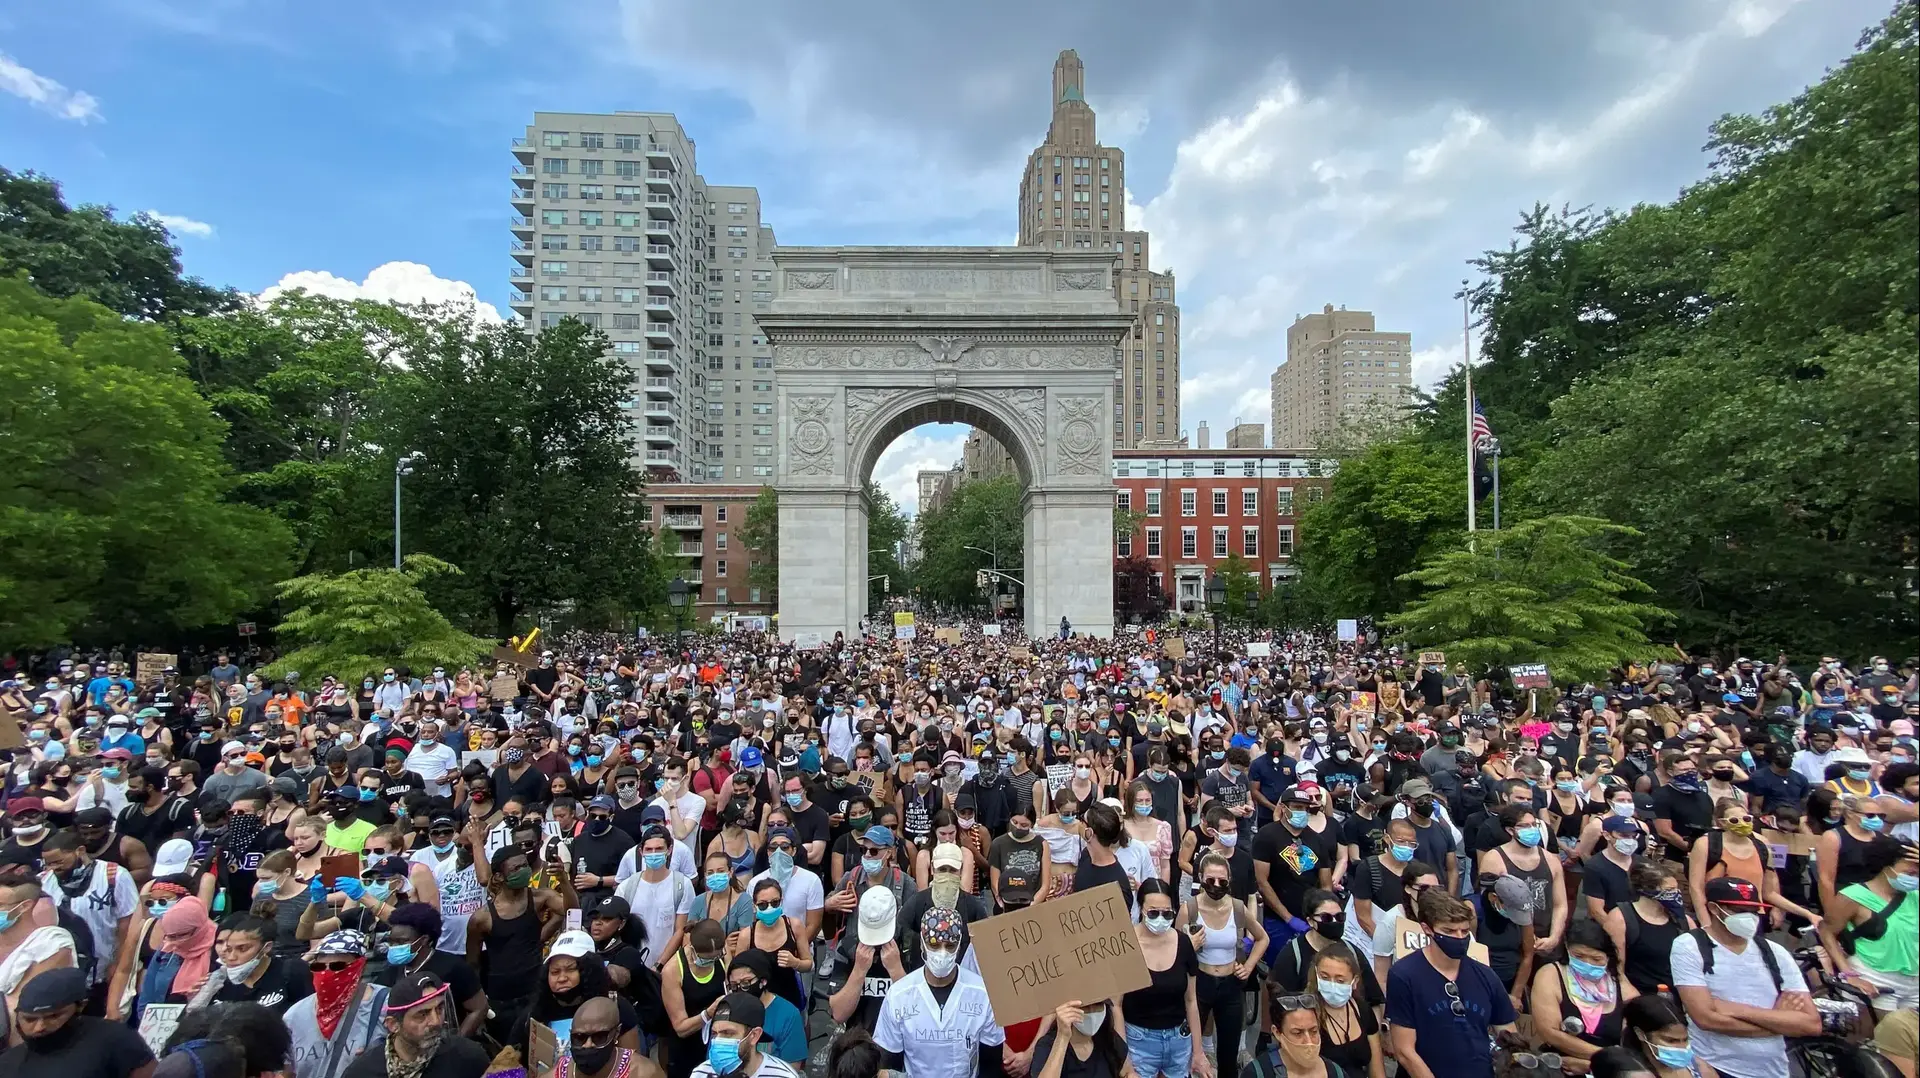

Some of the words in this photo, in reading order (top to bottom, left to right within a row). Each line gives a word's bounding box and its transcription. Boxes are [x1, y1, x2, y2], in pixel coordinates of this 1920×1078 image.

[1424, 653, 1442, 662] BLM
[386, 784, 410, 795] SQUAD
[998, 920, 1042, 953] END
[1058, 897, 1114, 937] RACIST
[1007, 954, 1064, 996] POLICE
[1071, 931, 1135, 968] TERROR
[894, 1004, 920, 1020] BLACK
[959, 1001, 984, 1015] LIVES
[916, 1028, 964, 1041] MATTER
